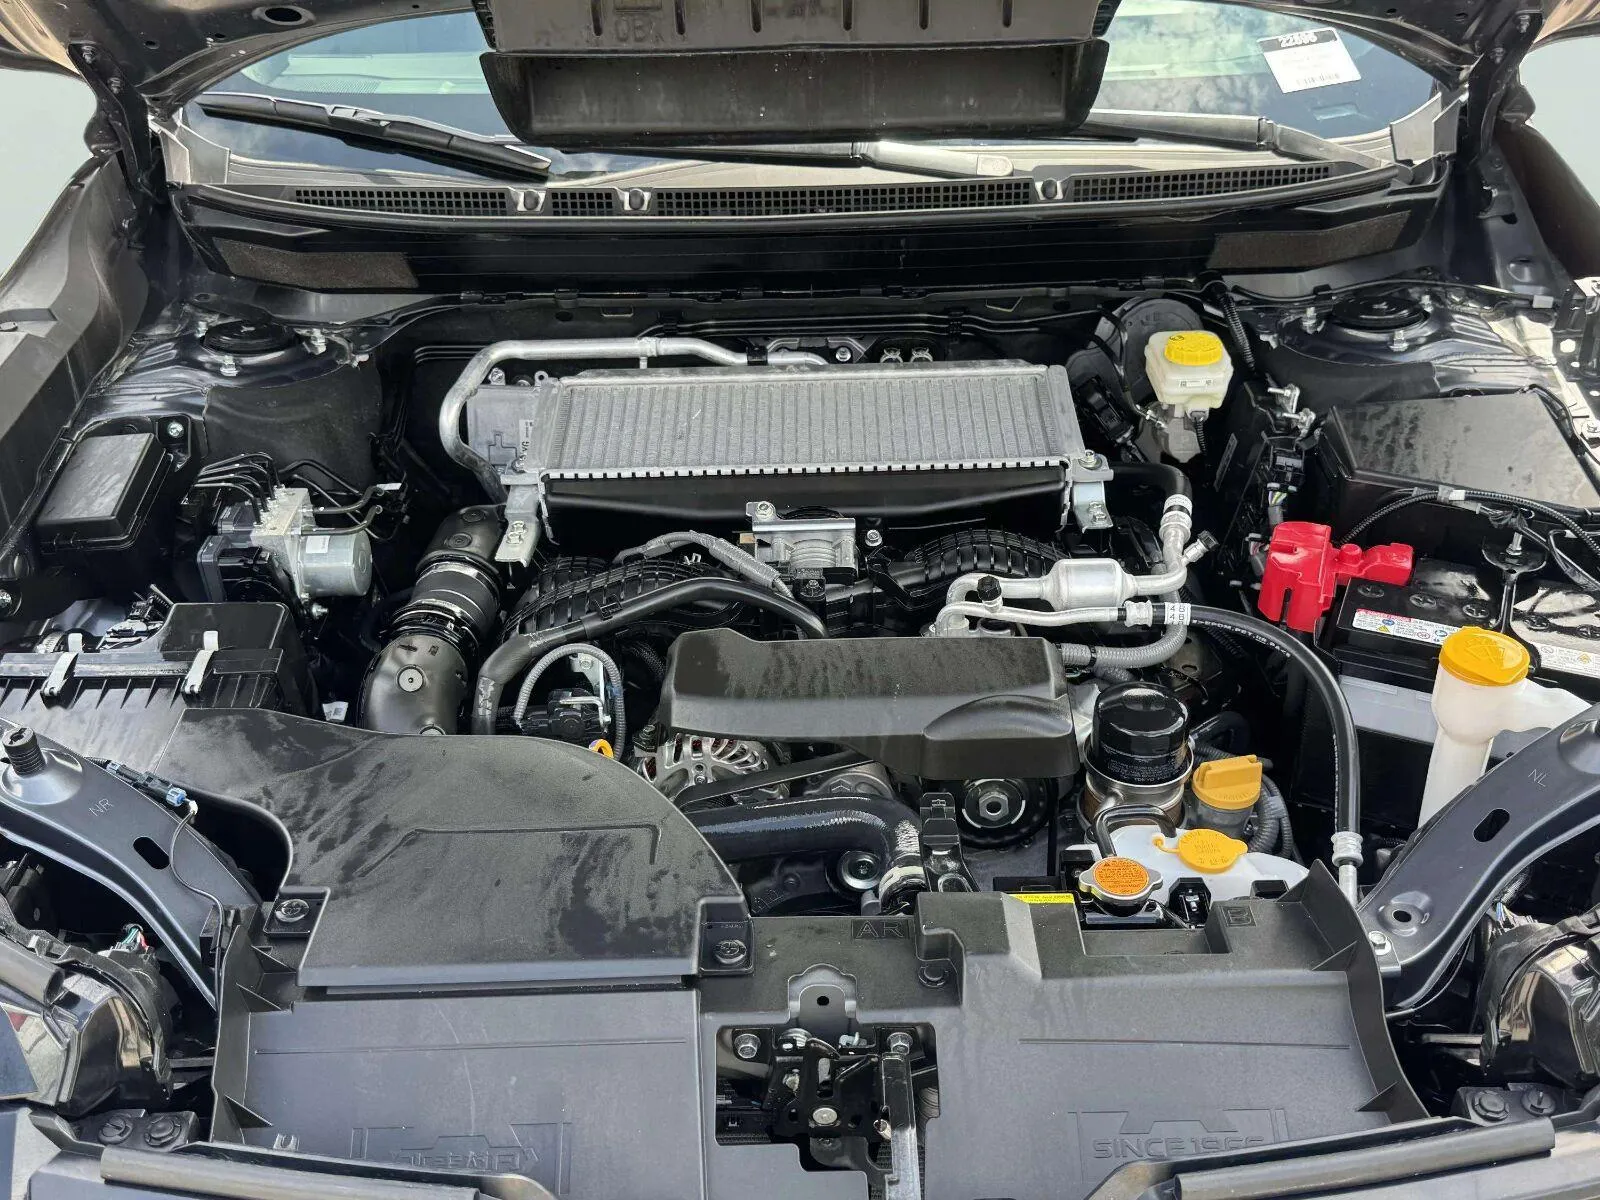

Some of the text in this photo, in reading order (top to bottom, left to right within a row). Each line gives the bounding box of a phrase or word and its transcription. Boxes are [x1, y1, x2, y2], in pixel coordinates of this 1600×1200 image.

[88, 798, 114, 817] NR
[855, 919, 905, 940] AR
[1092, 1137, 1185, 1160] SINCE
